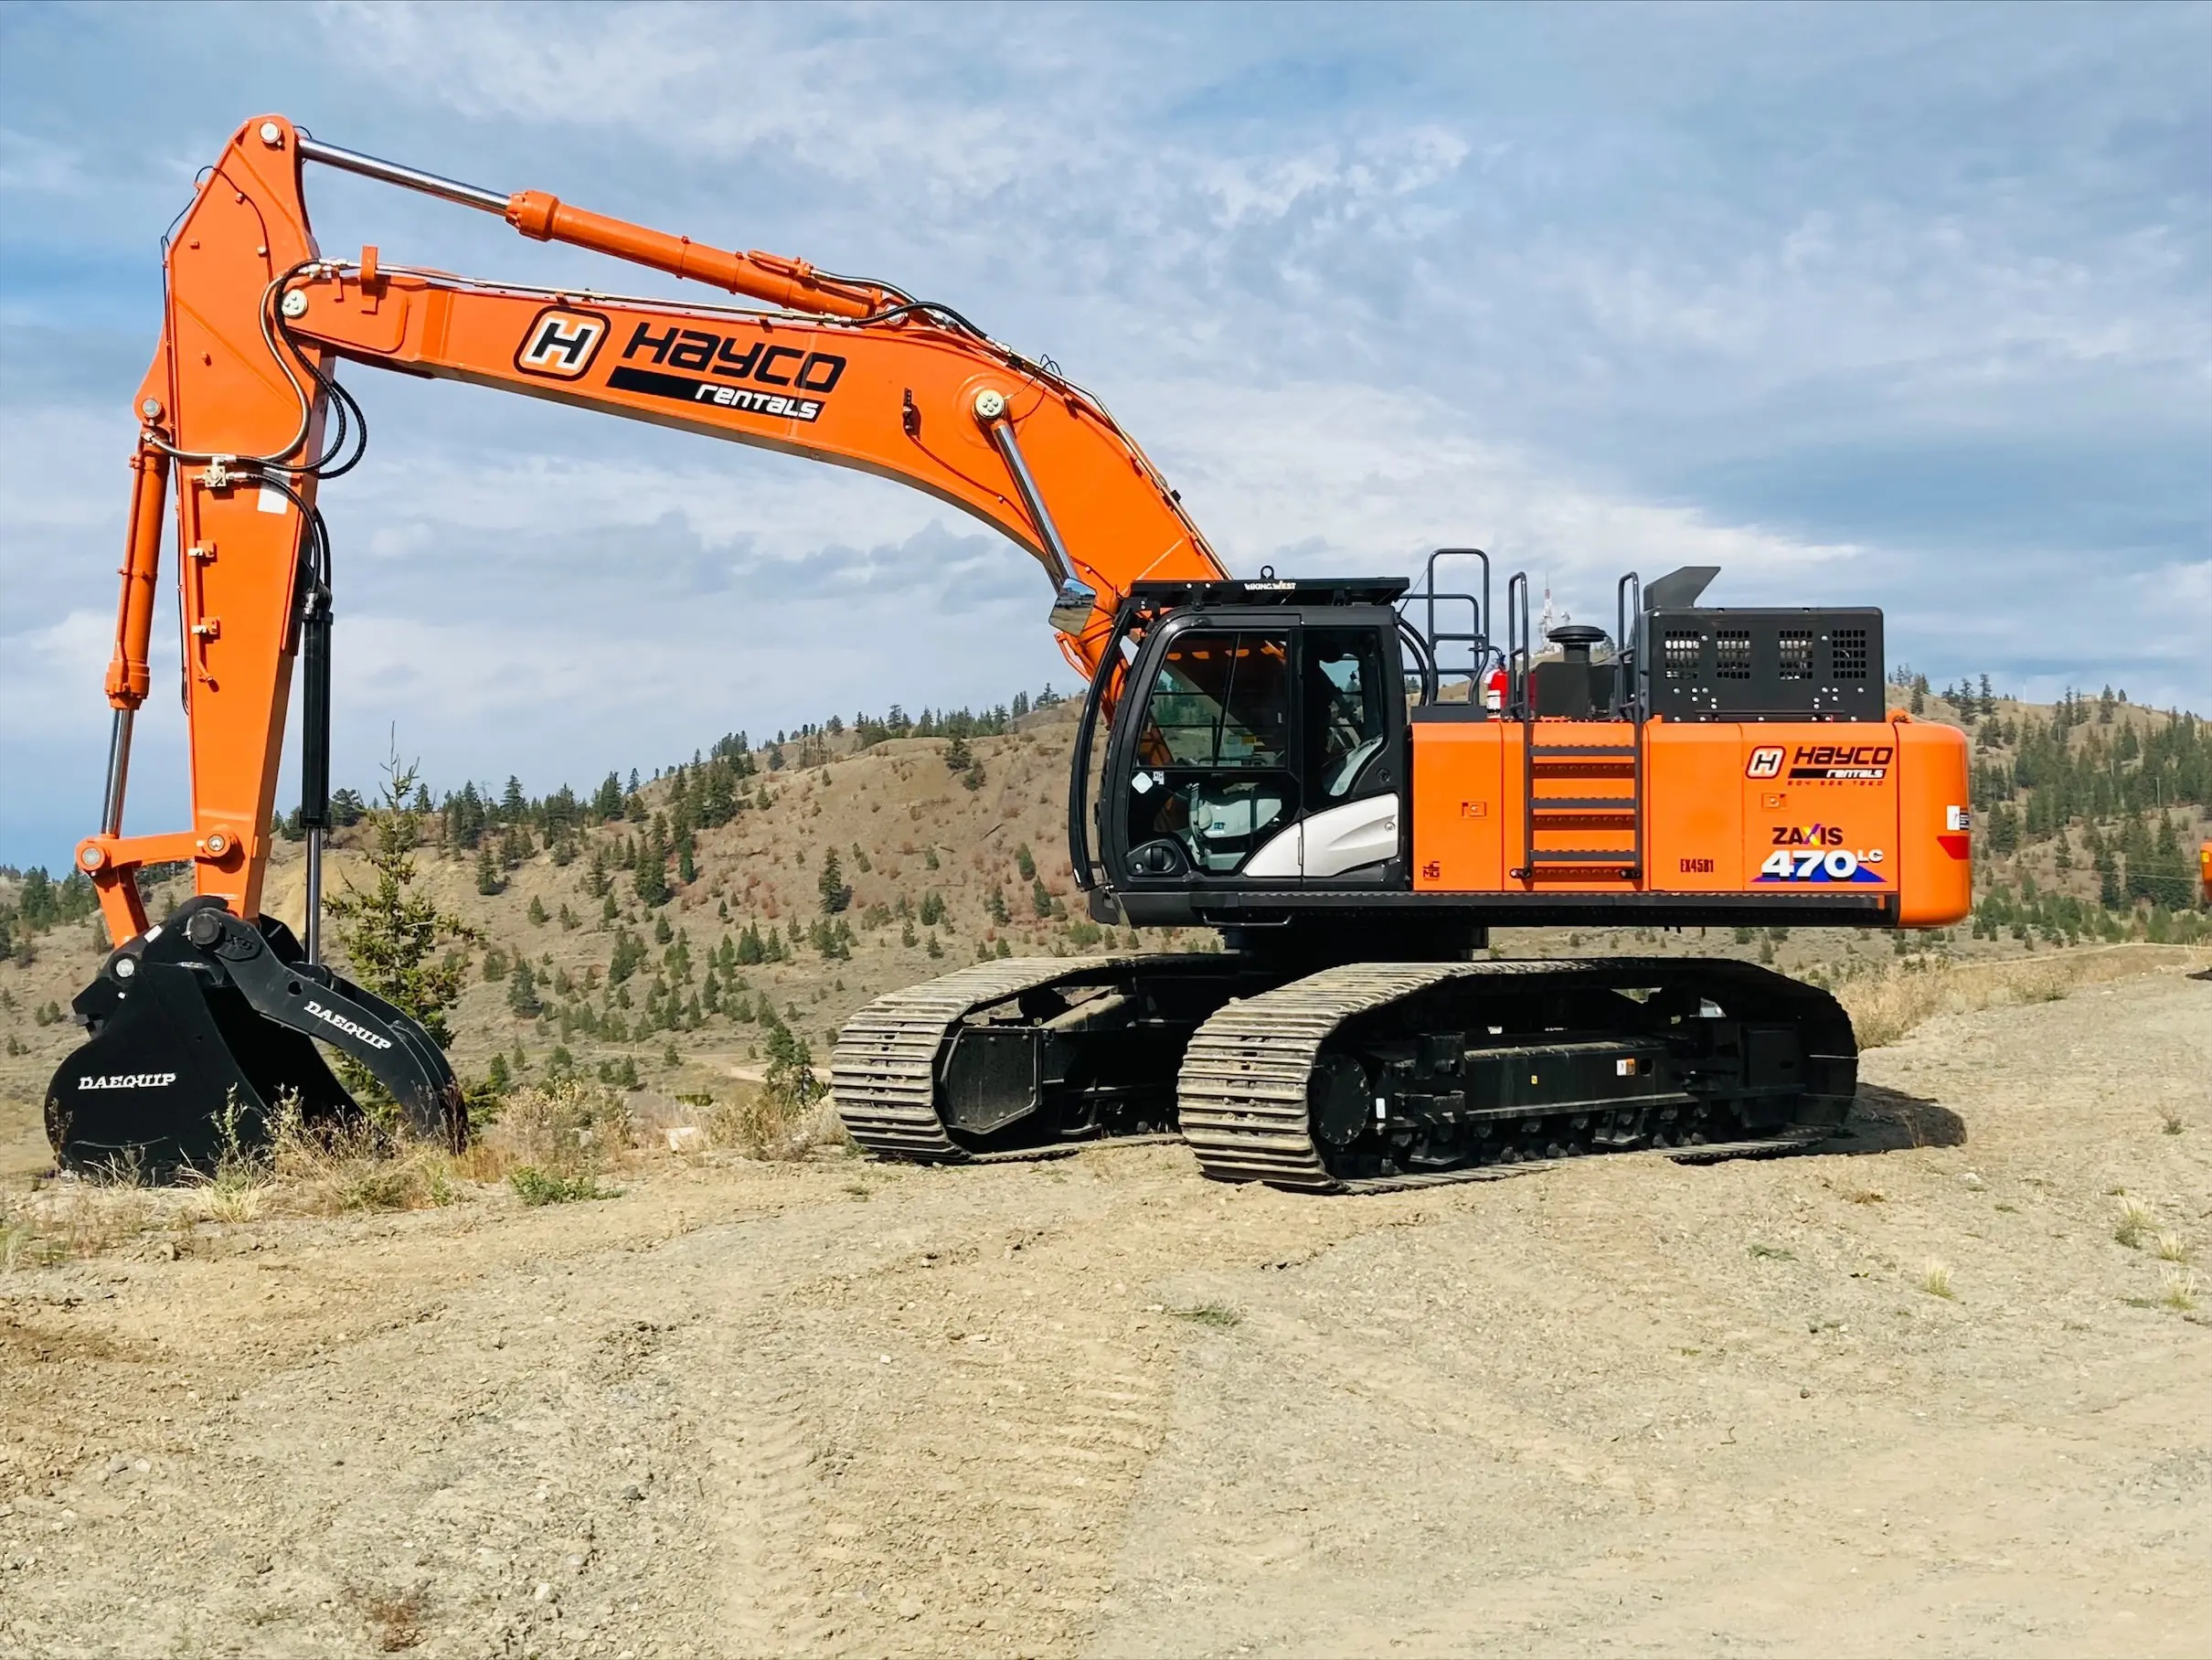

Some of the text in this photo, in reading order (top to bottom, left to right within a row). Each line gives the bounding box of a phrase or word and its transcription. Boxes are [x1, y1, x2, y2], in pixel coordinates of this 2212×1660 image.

[694, 383, 820, 420] rentals
[1825, 769, 1884, 779] rentals
[1771, 824, 1844, 846] ZAXIS
[1680, 858, 1714, 873] EX4581
[1760, 849, 1858, 881] 470
[303, 1000, 392, 1050] DAEQUIP
[78, 1072, 176, 1091] DAEQUIP
